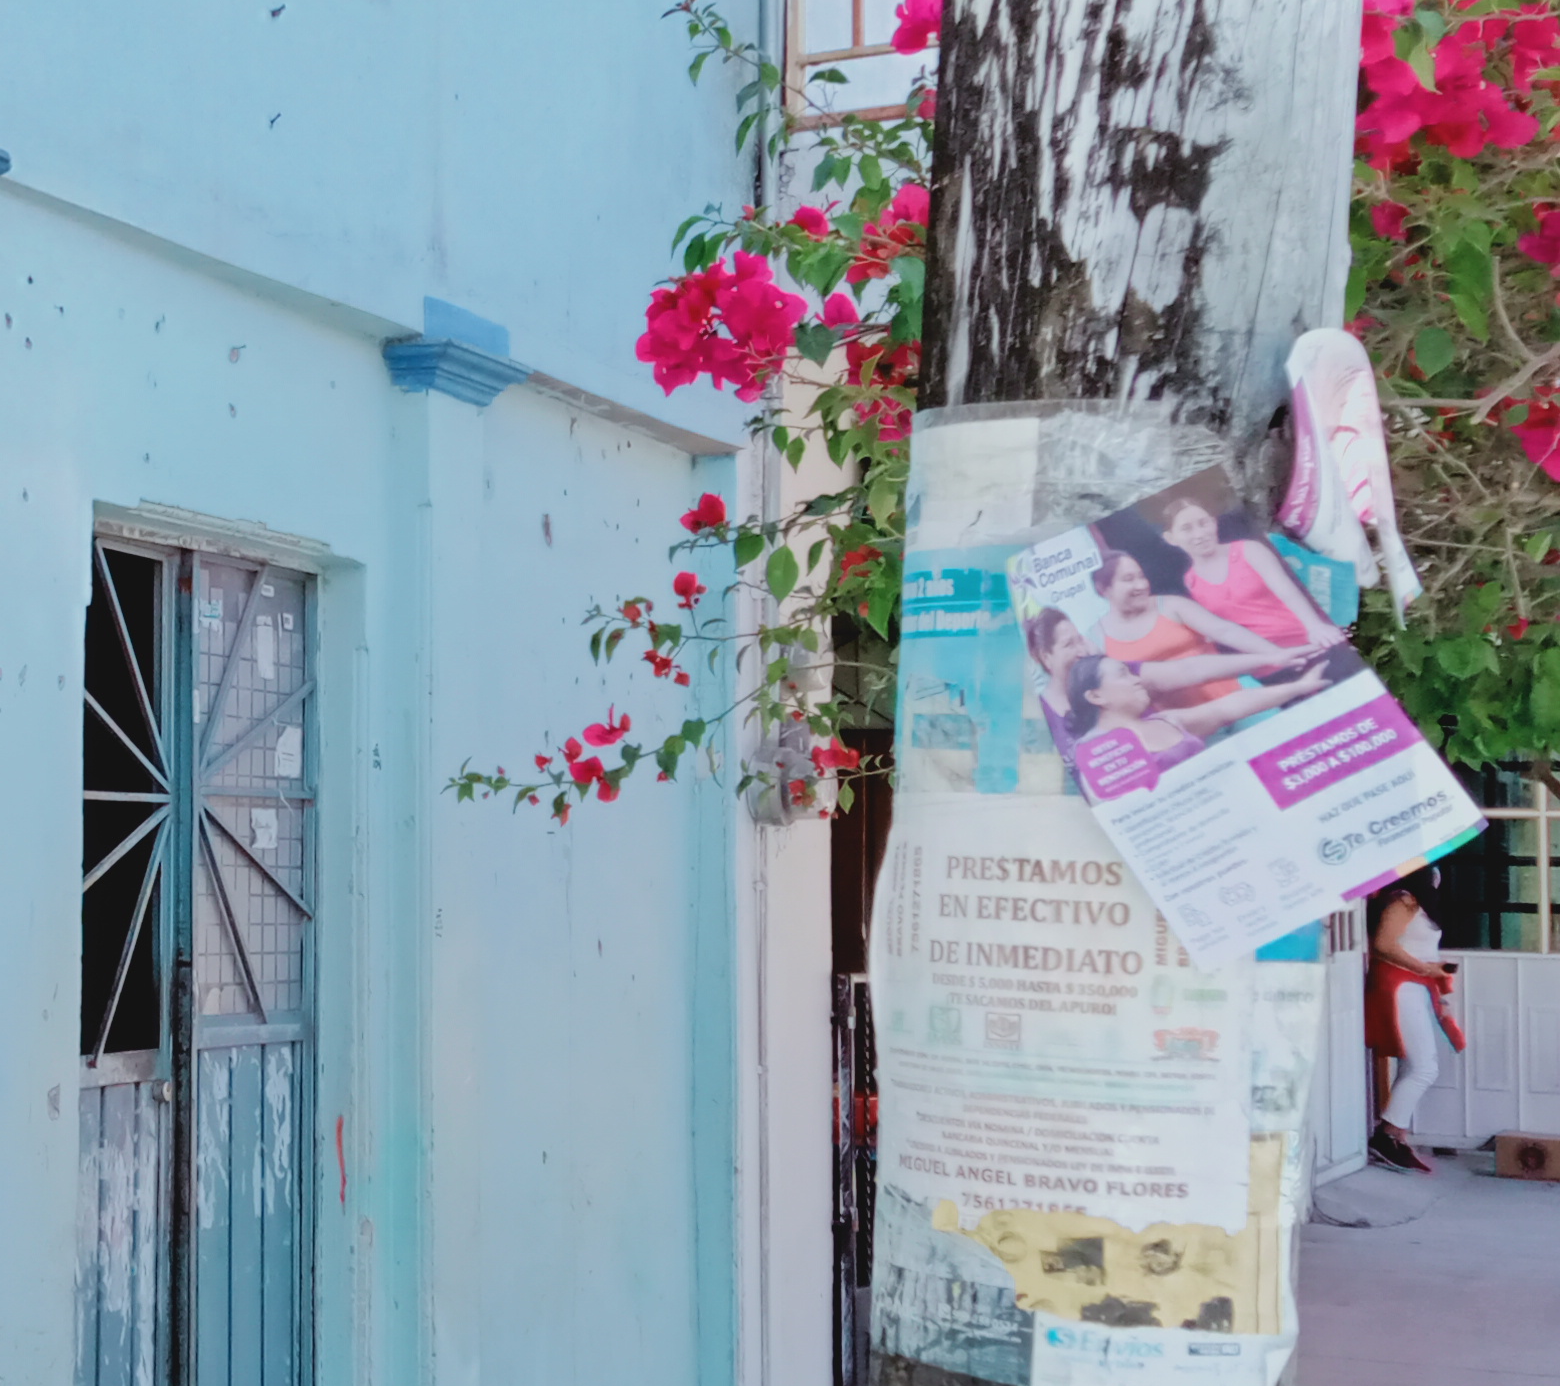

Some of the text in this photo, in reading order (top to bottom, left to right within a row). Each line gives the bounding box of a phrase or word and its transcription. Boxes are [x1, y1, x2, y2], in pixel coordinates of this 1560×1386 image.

[1038, 554, 1100, 589] Comunal
[1342, 832, 1366, 849] Te
[1367, 790, 1448, 835] Creemos
[939, 893, 1131, 927] EN EFECTIVO
[928, 939, 960, 964] DE
[965, 941, 1144, 976] INMEDIATO
[1016, 979, 1061, 994] HASTA
[1028, 998, 1056, 1013] DEL
[898, 1153, 1190, 1199] MIGUEL ANGEL BRAVO FLORES
